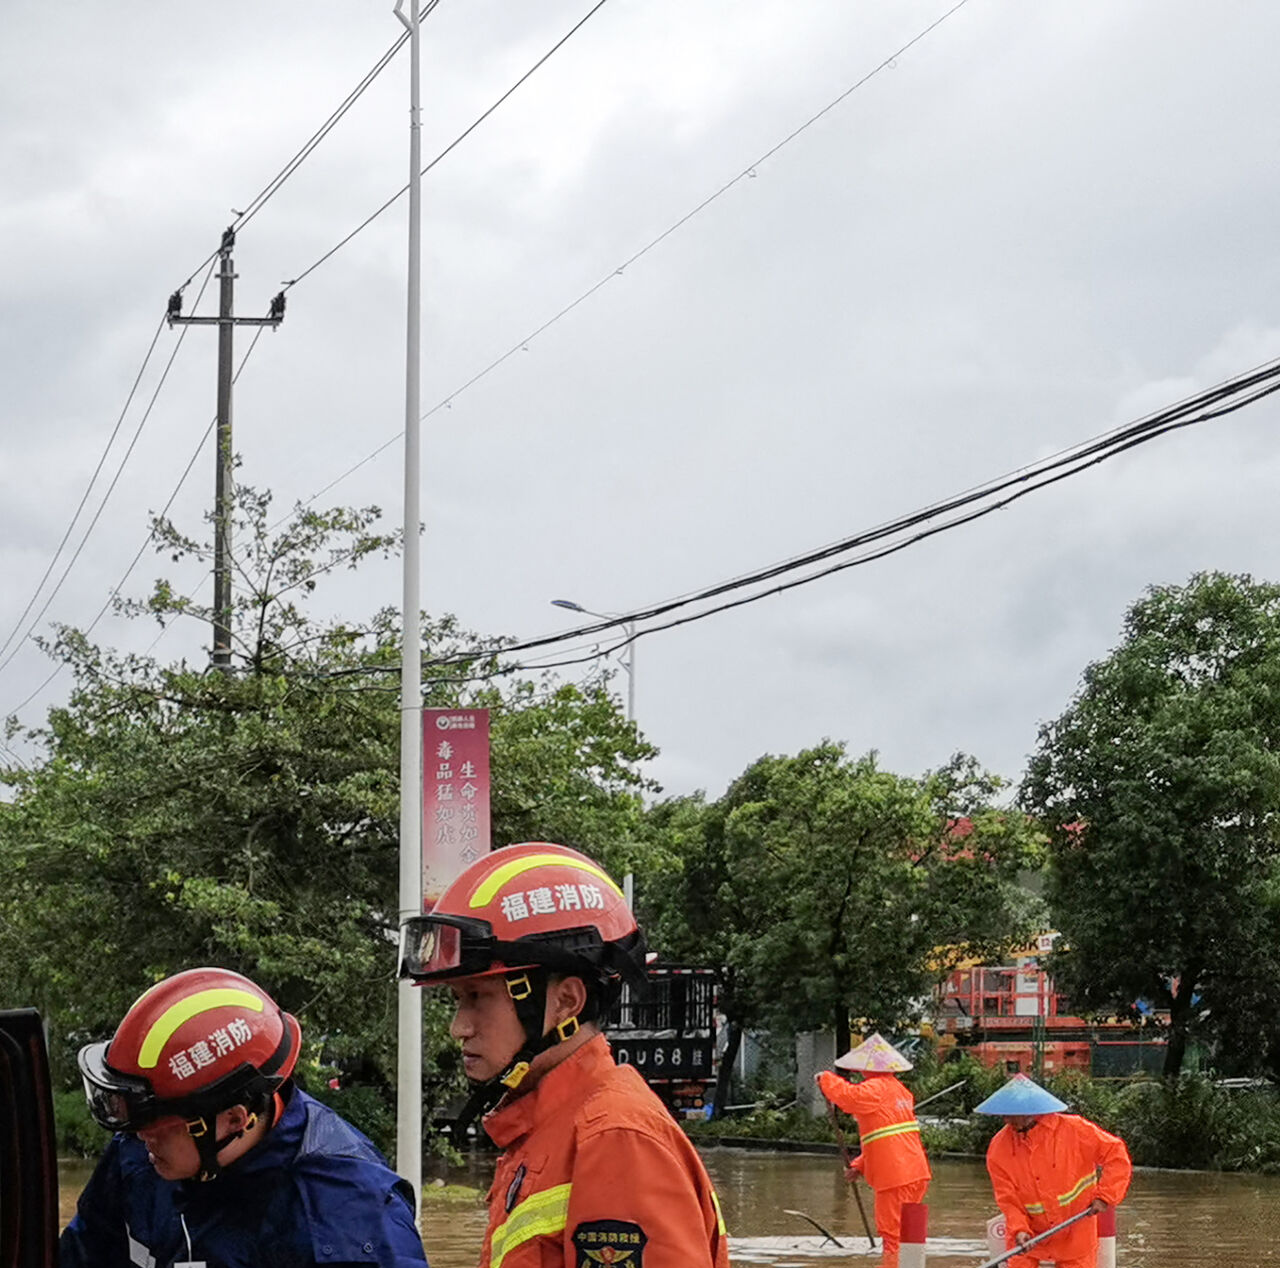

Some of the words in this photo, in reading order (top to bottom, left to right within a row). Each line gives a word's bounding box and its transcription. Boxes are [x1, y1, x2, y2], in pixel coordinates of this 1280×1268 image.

[500, 883, 605, 923] 福建消防
[168, 1017, 254, 1082] 福建消防
